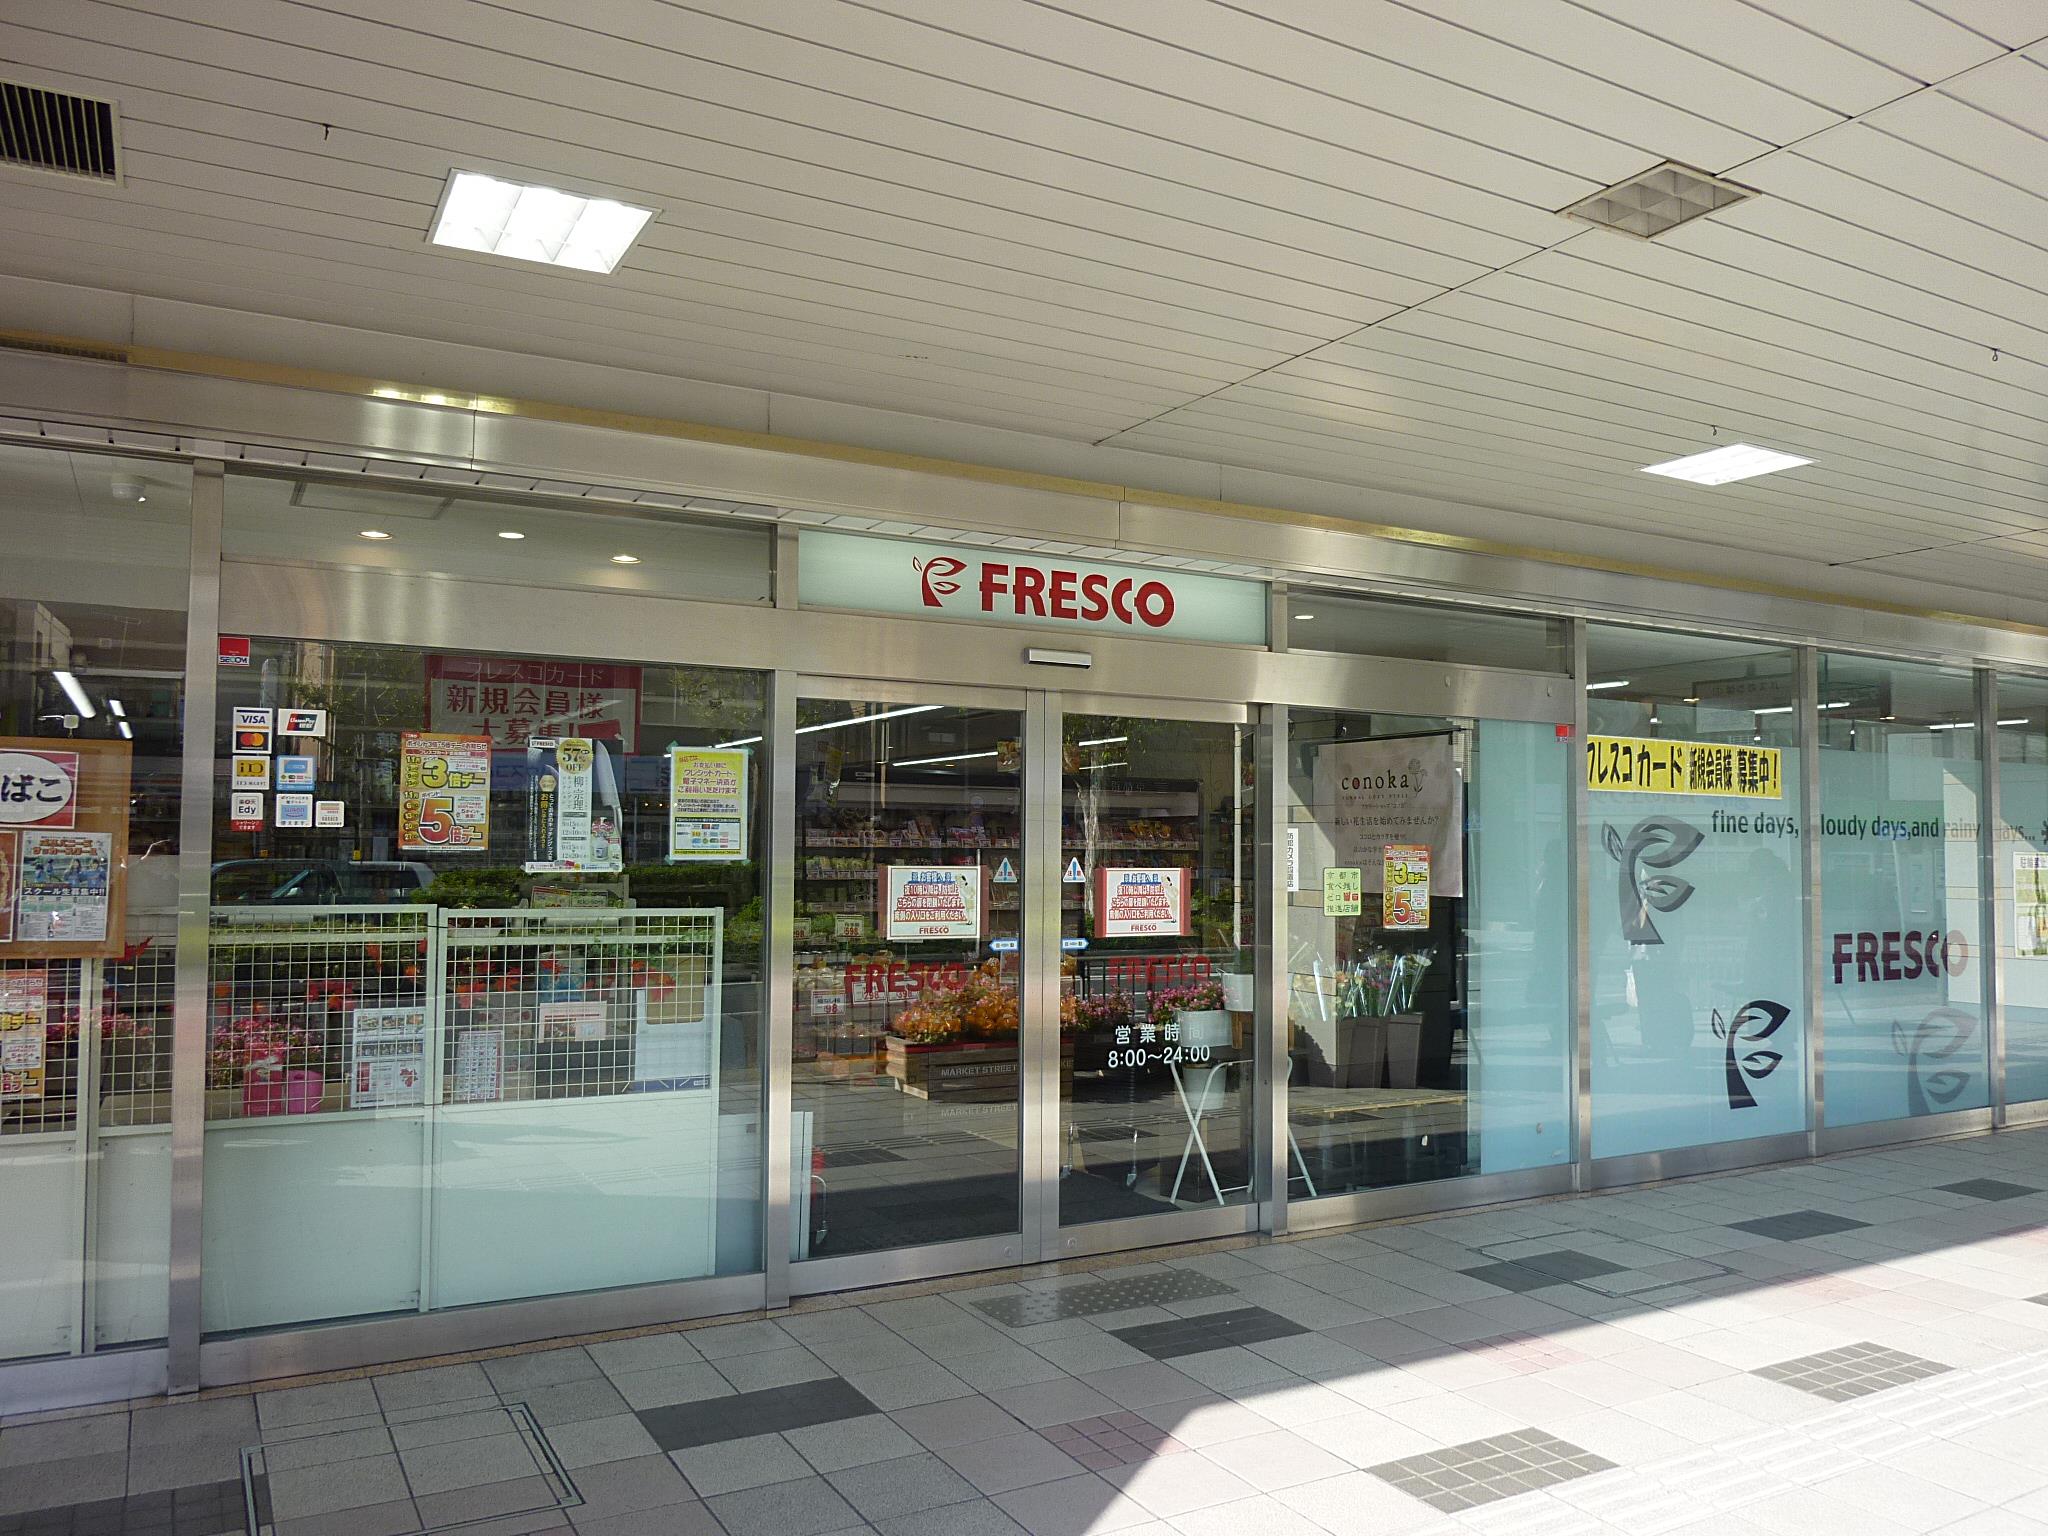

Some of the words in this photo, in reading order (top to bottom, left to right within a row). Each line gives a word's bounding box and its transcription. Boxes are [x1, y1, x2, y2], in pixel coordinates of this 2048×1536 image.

[979, 562, 1175, 628] FRESCO
[464, 660, 605, 685] フレスコカード
[447, 683, 605, 719] 新規会員様
[241, 714, 266, 724] VISA
[240, 762, 263, 772] iD
[566, 763, 584, 771] OFF
[1341, 769, 1409, 790] conoka
[239, 806, 257, 815] Edy
[1712, 810, 1748, 833] fine
[1754, 811, 1799, 838] days,
[1821, 814, 1867, 840] loudy
[1944, 818, 1980, 841] rainy
[1832, 930, 1969, 984] FRESCO
[844, 961, 966, 1000] FRESCO
[941, 1066, 980, 1077] MARKET
[982, 1063, 1018, 1074] STREET
